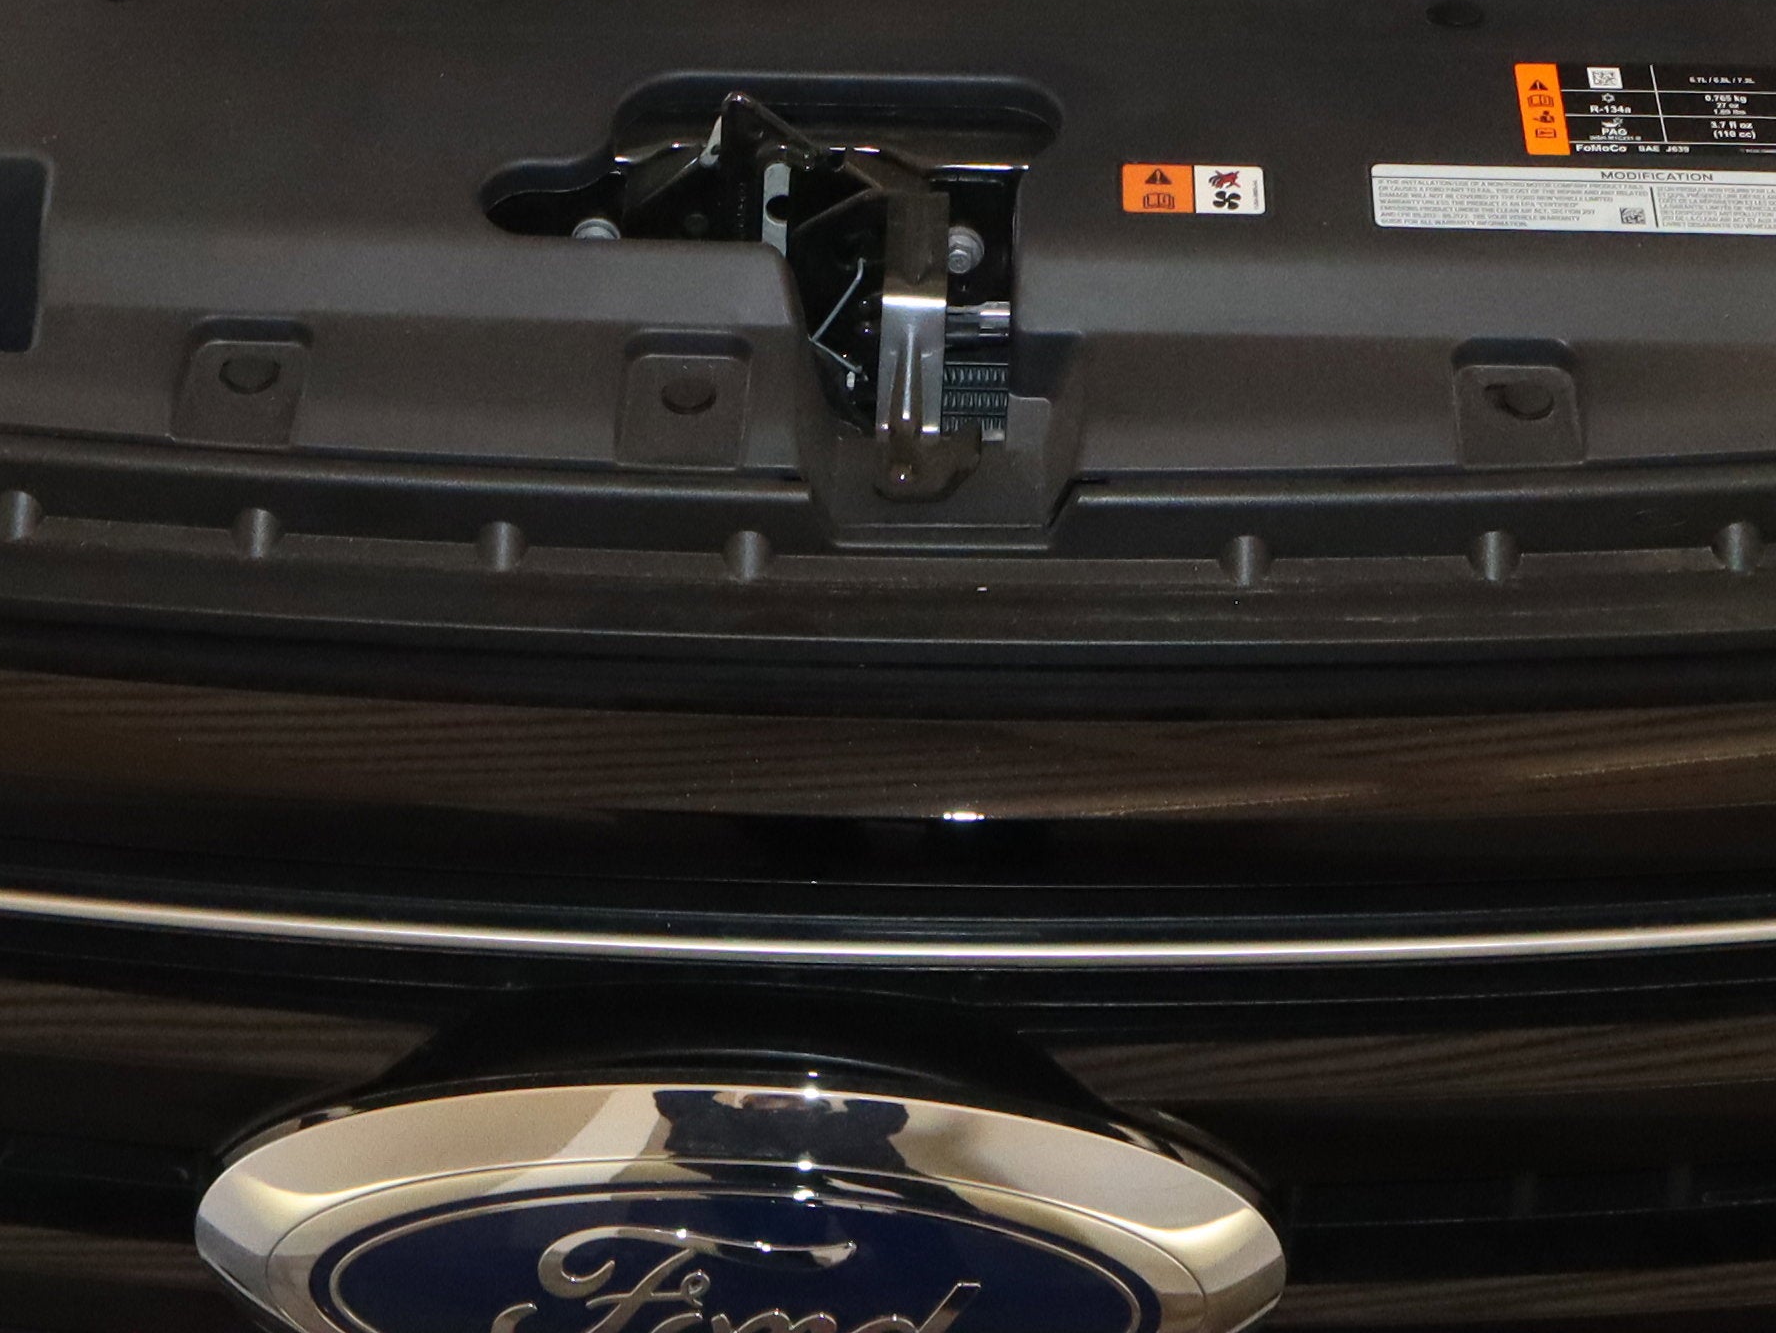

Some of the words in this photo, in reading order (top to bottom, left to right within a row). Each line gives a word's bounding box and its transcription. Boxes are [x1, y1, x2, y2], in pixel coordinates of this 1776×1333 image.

[1734, 95, 1748, 104] kg
[1590, 105, 1632, 113] R-134a
[1710, 121, 1725, 129] 3.7
[1601, 127, 1628, 136] PAG
[1576, 144, 1628, 153] FoMoCo
[1638, 145, 1660, 153] SAE
[1666, 145, 1690, 153] J639
[1600, 171, 1714, 182] MODIFICATION
